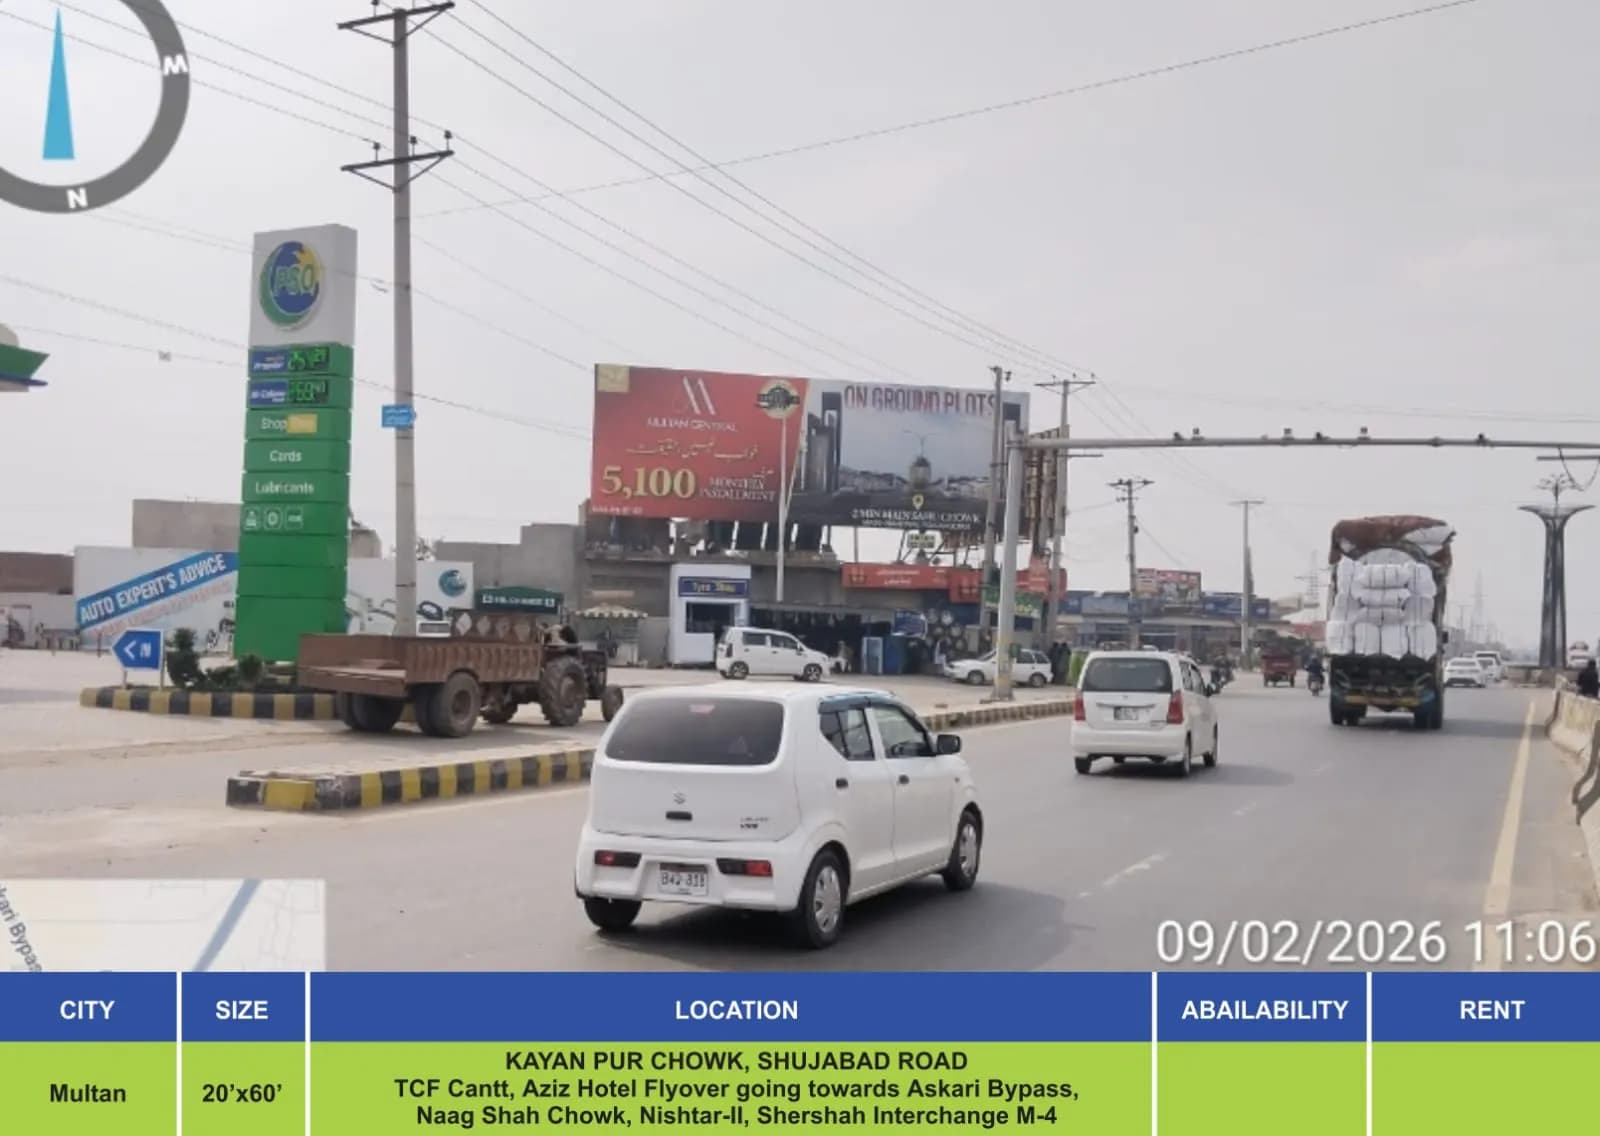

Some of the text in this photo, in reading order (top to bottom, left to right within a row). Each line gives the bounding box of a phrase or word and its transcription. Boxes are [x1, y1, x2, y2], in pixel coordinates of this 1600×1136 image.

[844, 385, 867, 409] ON
[871, 387, 940, 414] GROUND
[261, 416, 287, 433] Shop
[647, 416, 689, 428] MULTAN
[269, 450, 303, 462] Cards
[255, 482, 314, 494] Lubricants
[600, 464, 696, 499] 5,100
[80, 594, 115, 624] AUTO
[115, 573, 177, 609] EXPERT'S
[178, 553, 226, 584] ADVICE
